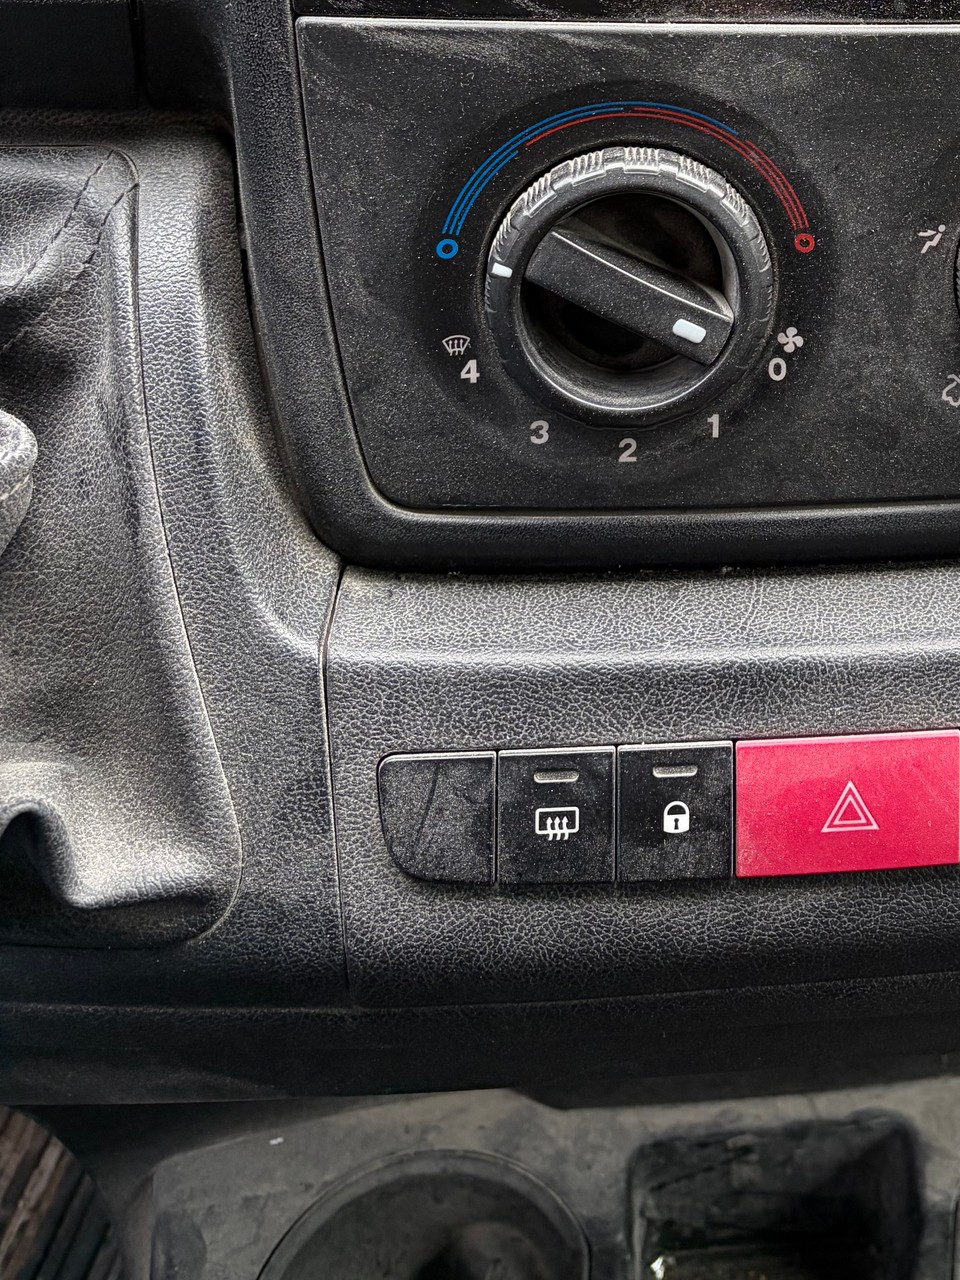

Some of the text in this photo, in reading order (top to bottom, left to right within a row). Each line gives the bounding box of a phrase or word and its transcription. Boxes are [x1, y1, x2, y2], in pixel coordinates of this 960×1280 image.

[460, 359, 480, 384] 4
[767, 357, 787, 382] 0
[529, 420, 550, 444] 3
[706, 413, 720, 438] 1
[618, 438, 638, 463] 2
